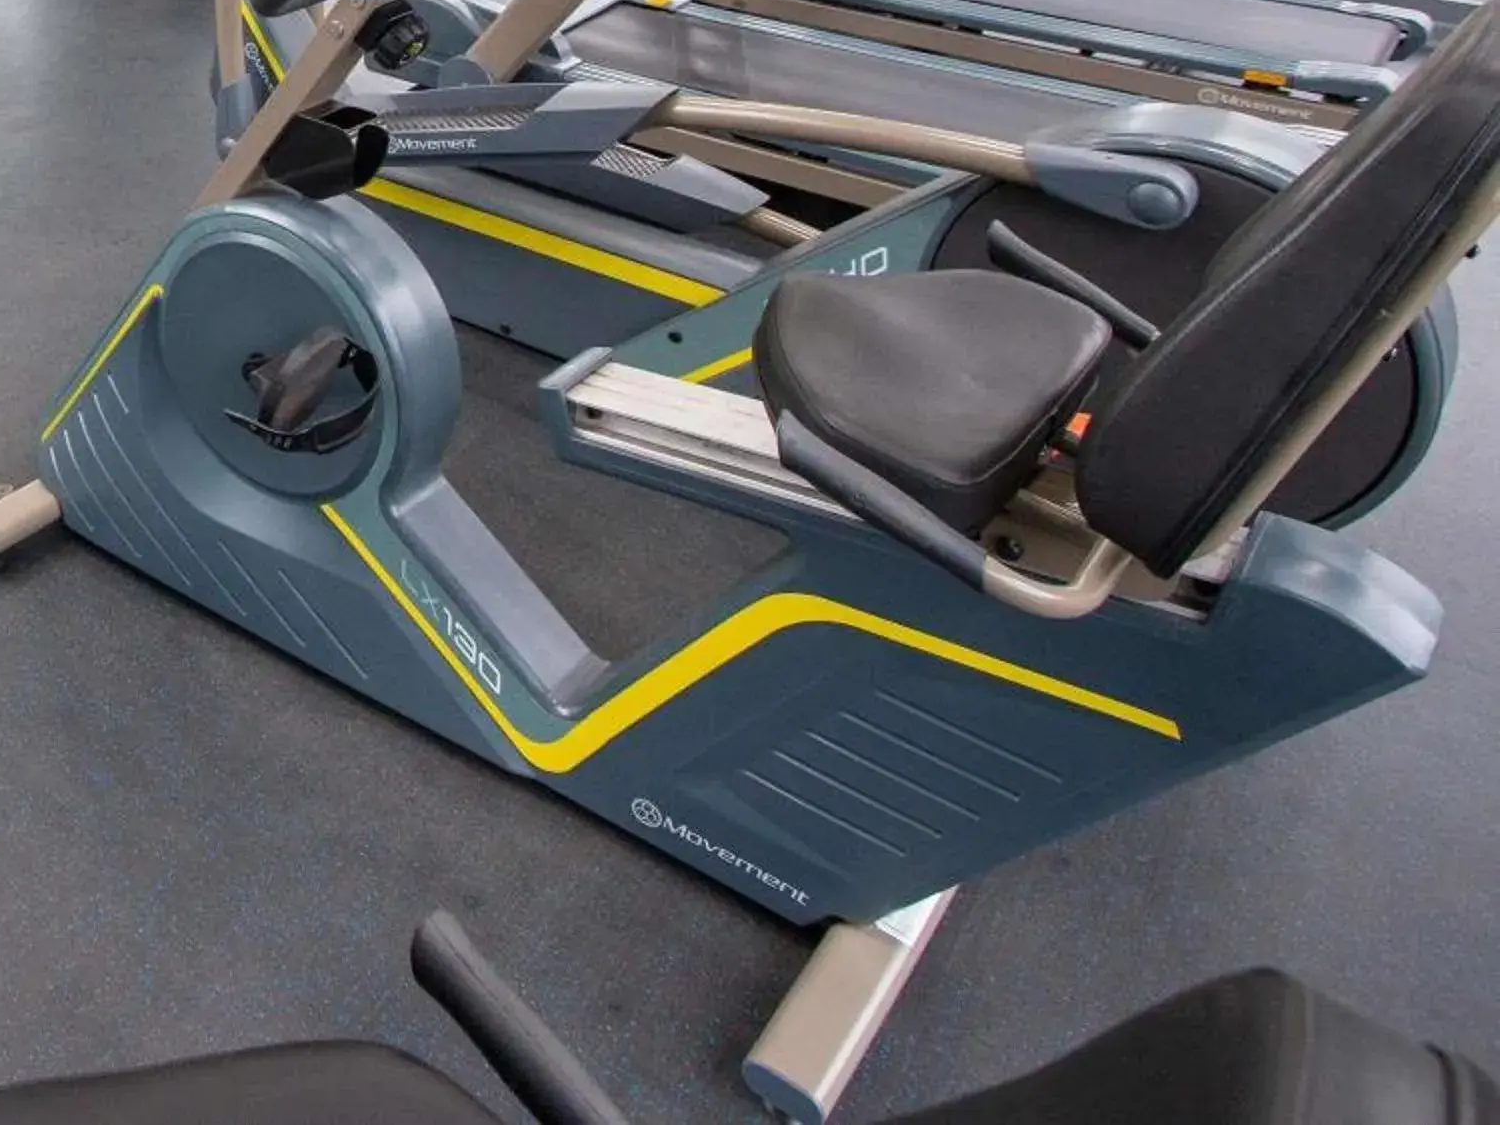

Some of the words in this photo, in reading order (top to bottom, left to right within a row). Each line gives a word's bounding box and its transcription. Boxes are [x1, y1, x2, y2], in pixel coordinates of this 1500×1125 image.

[400, 137, 478, 151] Movement
[399, 559, 502, 697] LX130
[662, 817, 810, 907] Movement
